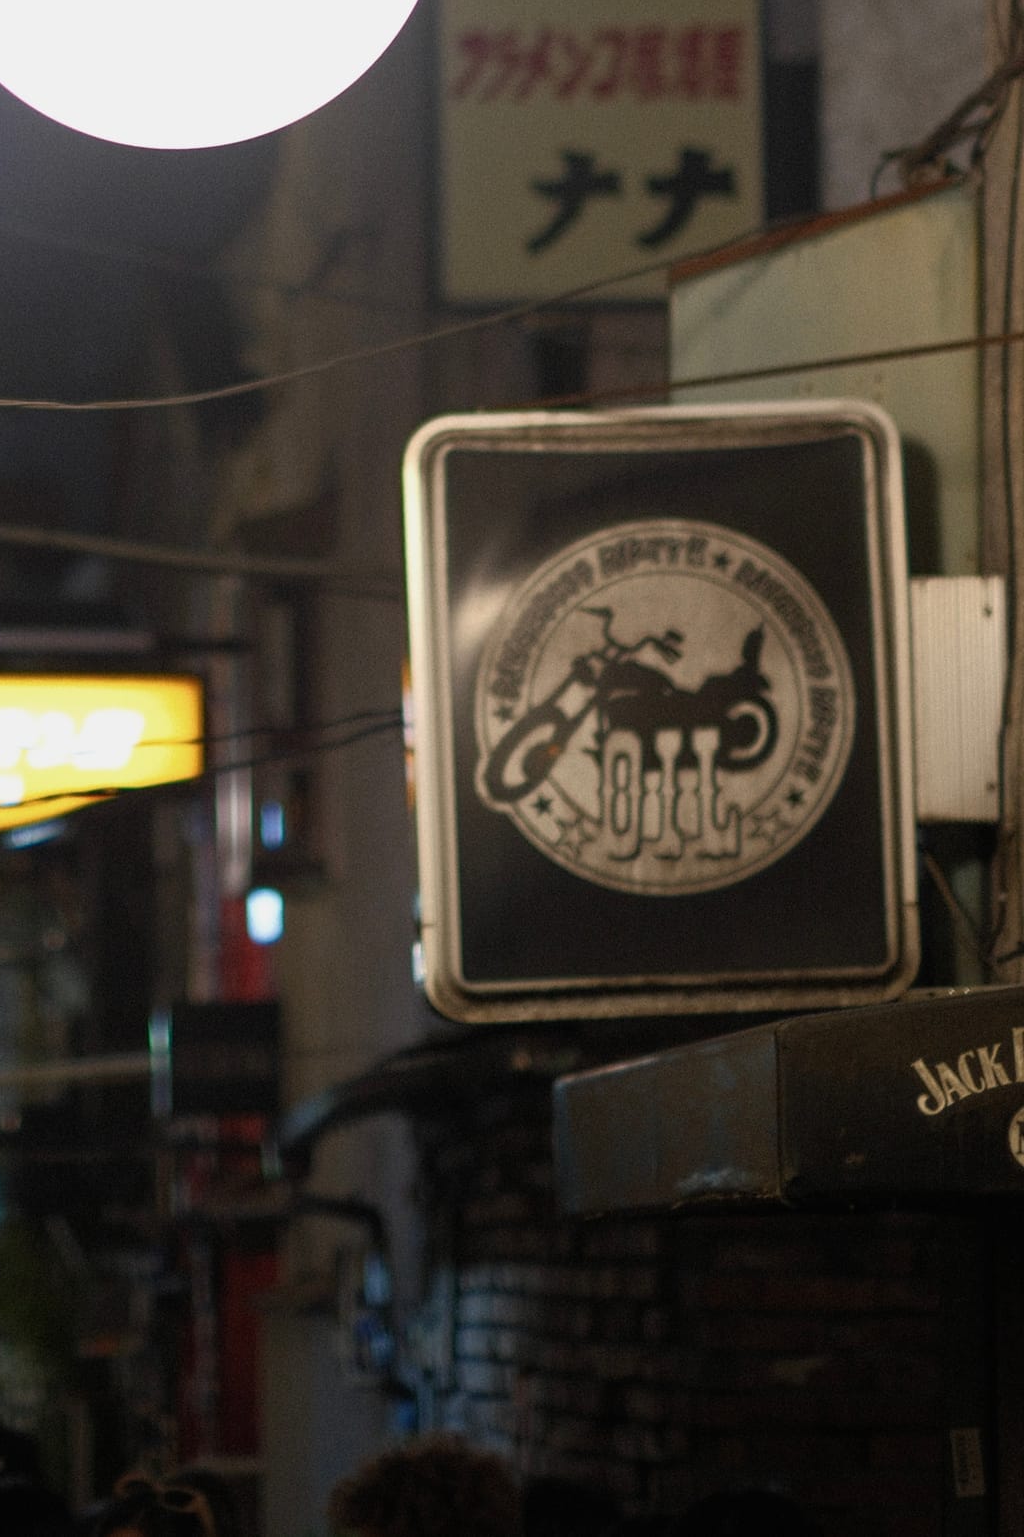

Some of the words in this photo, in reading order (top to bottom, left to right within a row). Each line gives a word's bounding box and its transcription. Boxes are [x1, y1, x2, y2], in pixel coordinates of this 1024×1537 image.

[527, 146, 737, 254] ナナ
[600, 725, 743, 862] OIL
[910, 1042, 1013, 1117] JACK
